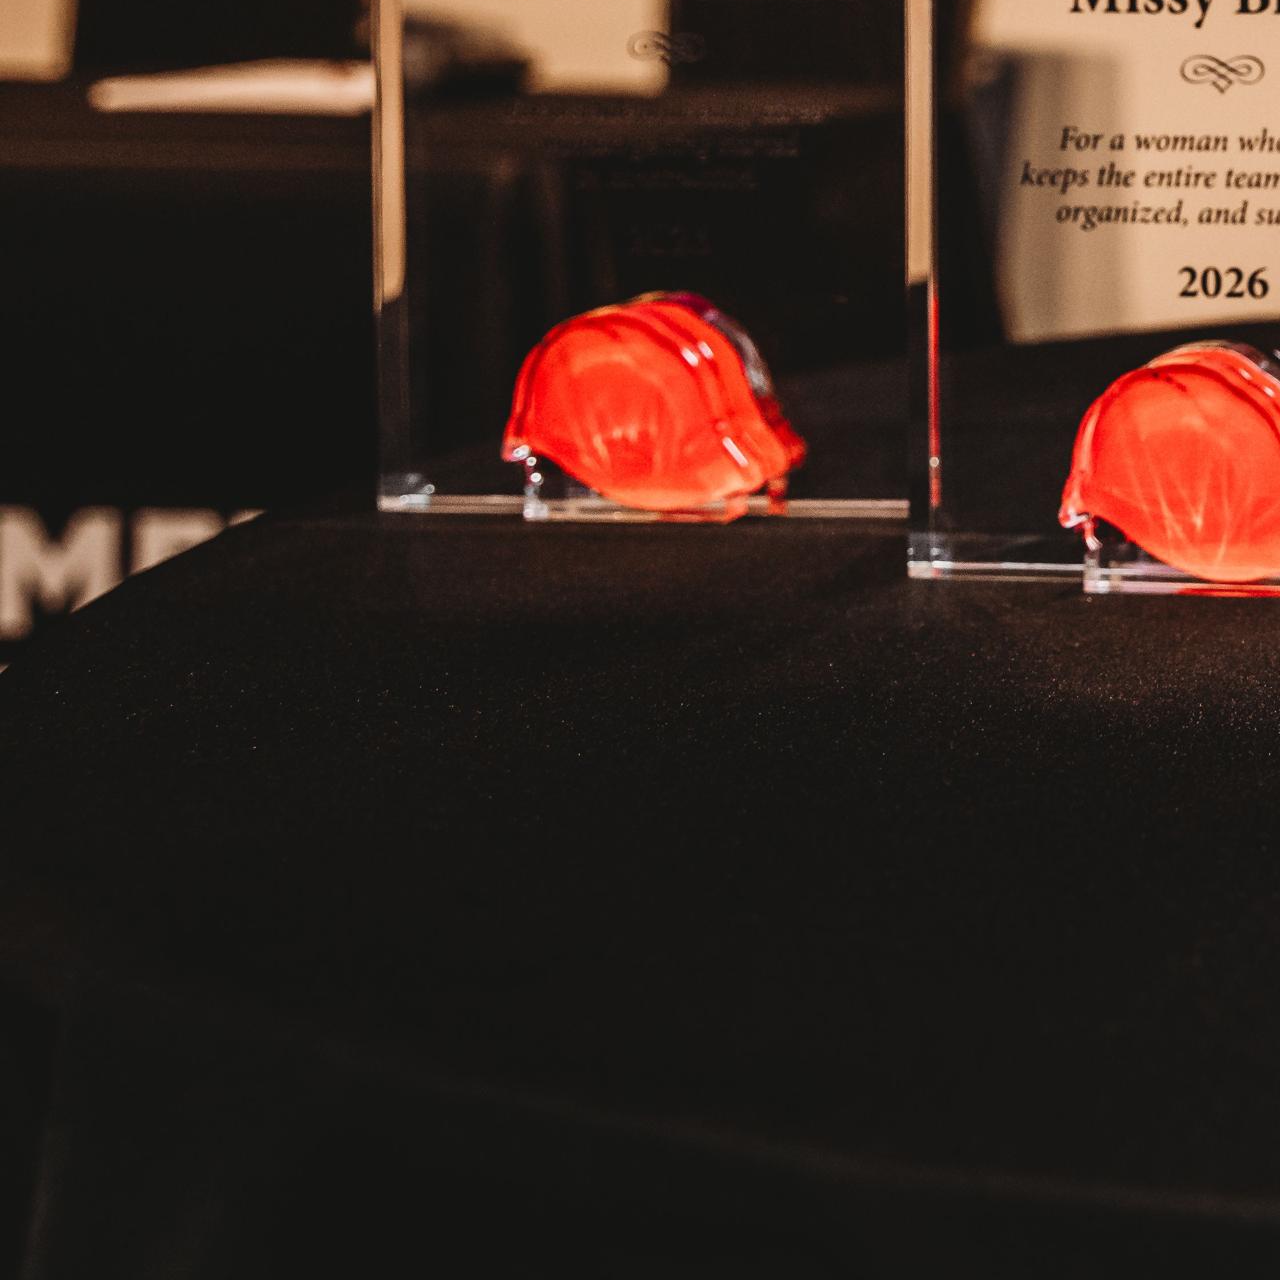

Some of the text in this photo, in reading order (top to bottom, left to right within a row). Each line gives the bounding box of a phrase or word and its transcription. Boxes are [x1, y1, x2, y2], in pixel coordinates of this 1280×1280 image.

[1060, 127, 1105, 153] For
[1110, 135, 1124, 152] a
[1134, 134, 1228, 152] woman
[1020, 162, 1090, 196] keeps
[1097, 162, 1136, 188] the
[1143, 164, 1218, 190] entire
[1055, 199, 1189, 231] organized,
[1197, 200, 1247, 226] and
[1178, 266, 1270, 299] 2026
